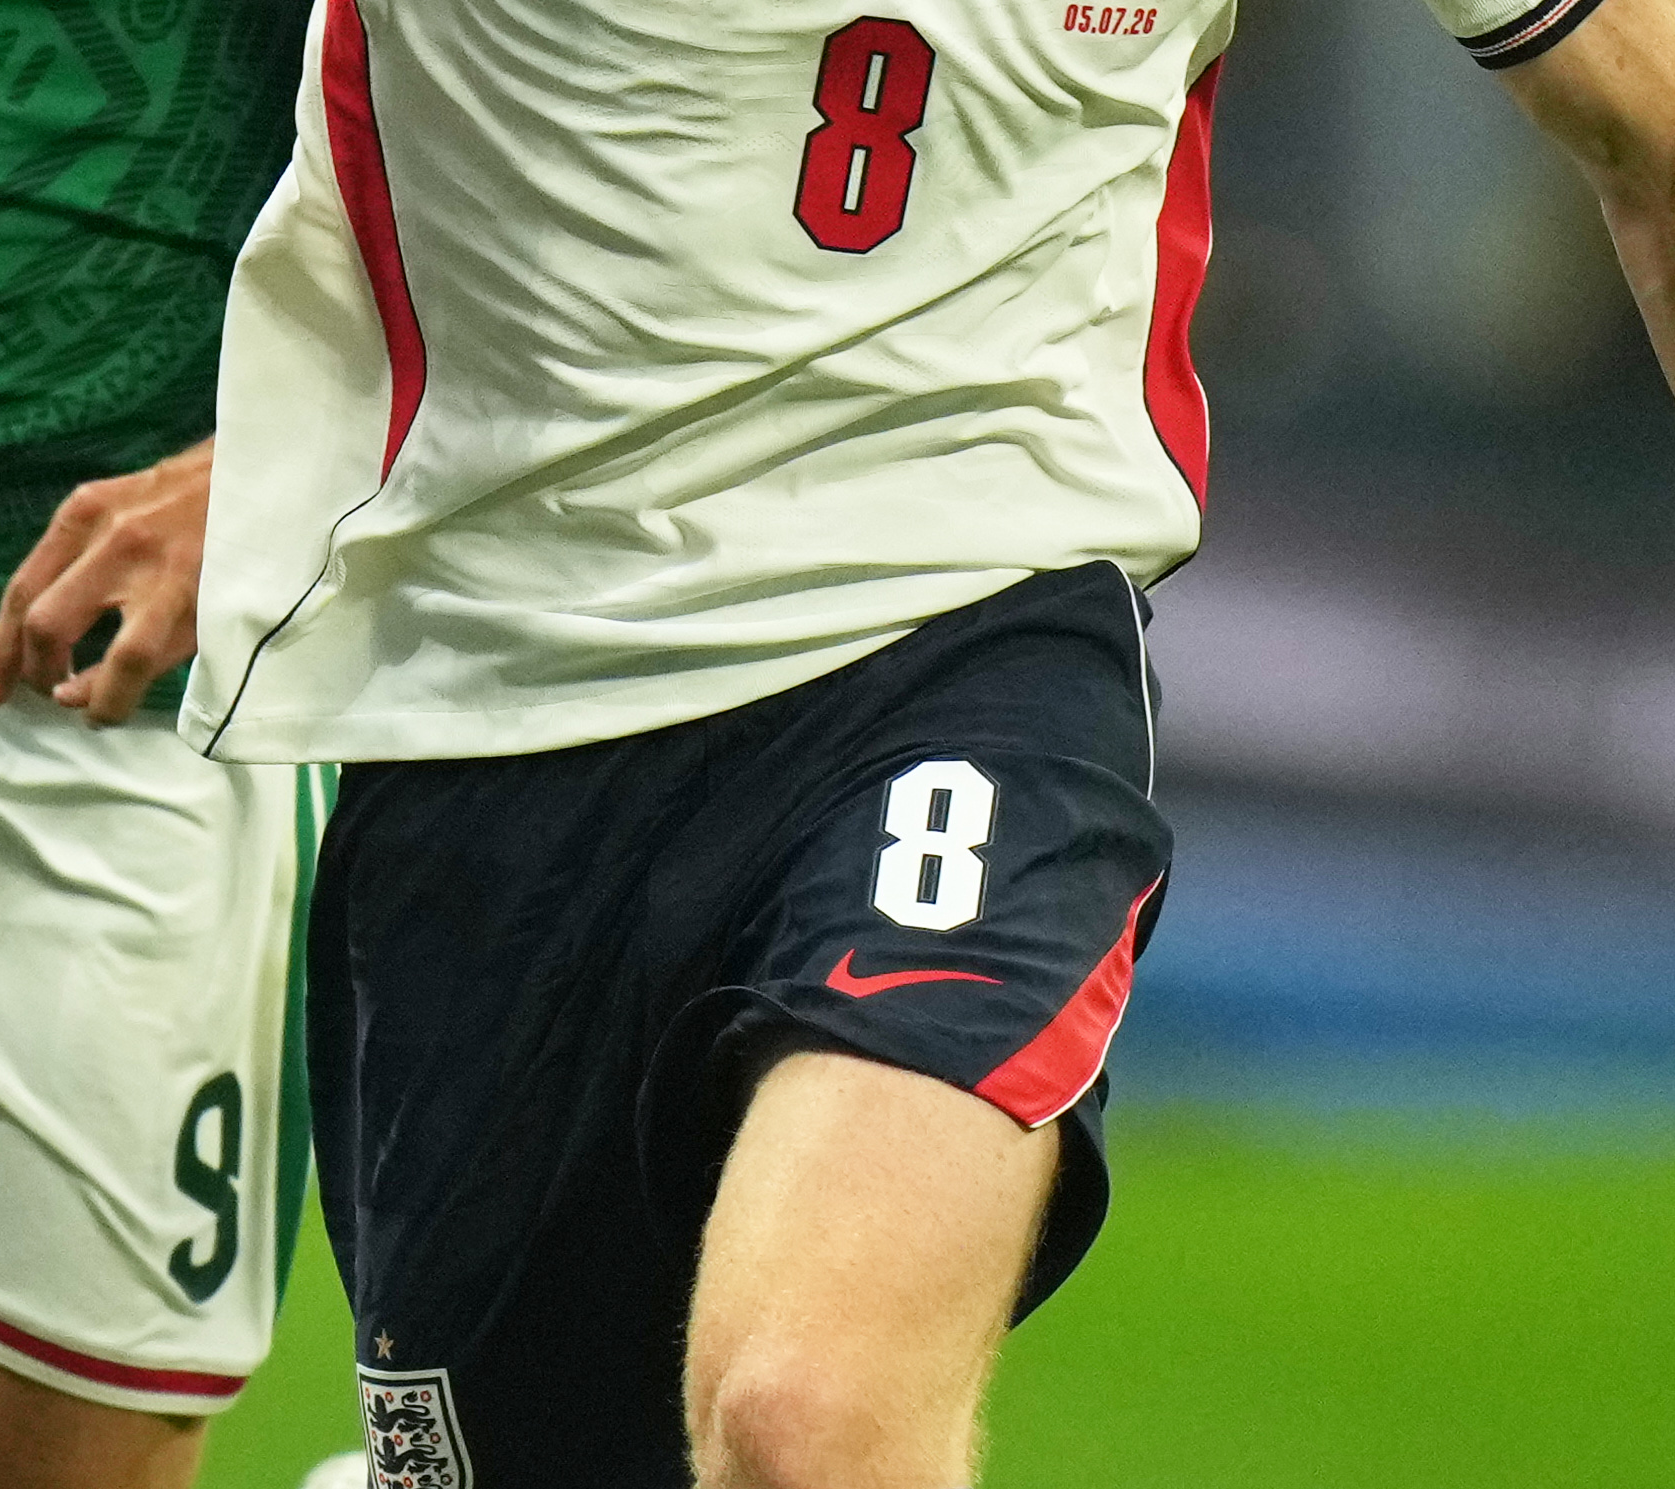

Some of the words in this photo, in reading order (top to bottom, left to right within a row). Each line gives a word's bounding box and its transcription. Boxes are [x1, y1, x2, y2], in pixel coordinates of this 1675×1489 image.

[1063, 3, 1158, 35] 05.07.26
[792, 15, 936, 254] 8
[871, 758, 997, 933] 8
[168, 1071, 243, 1304] 9
